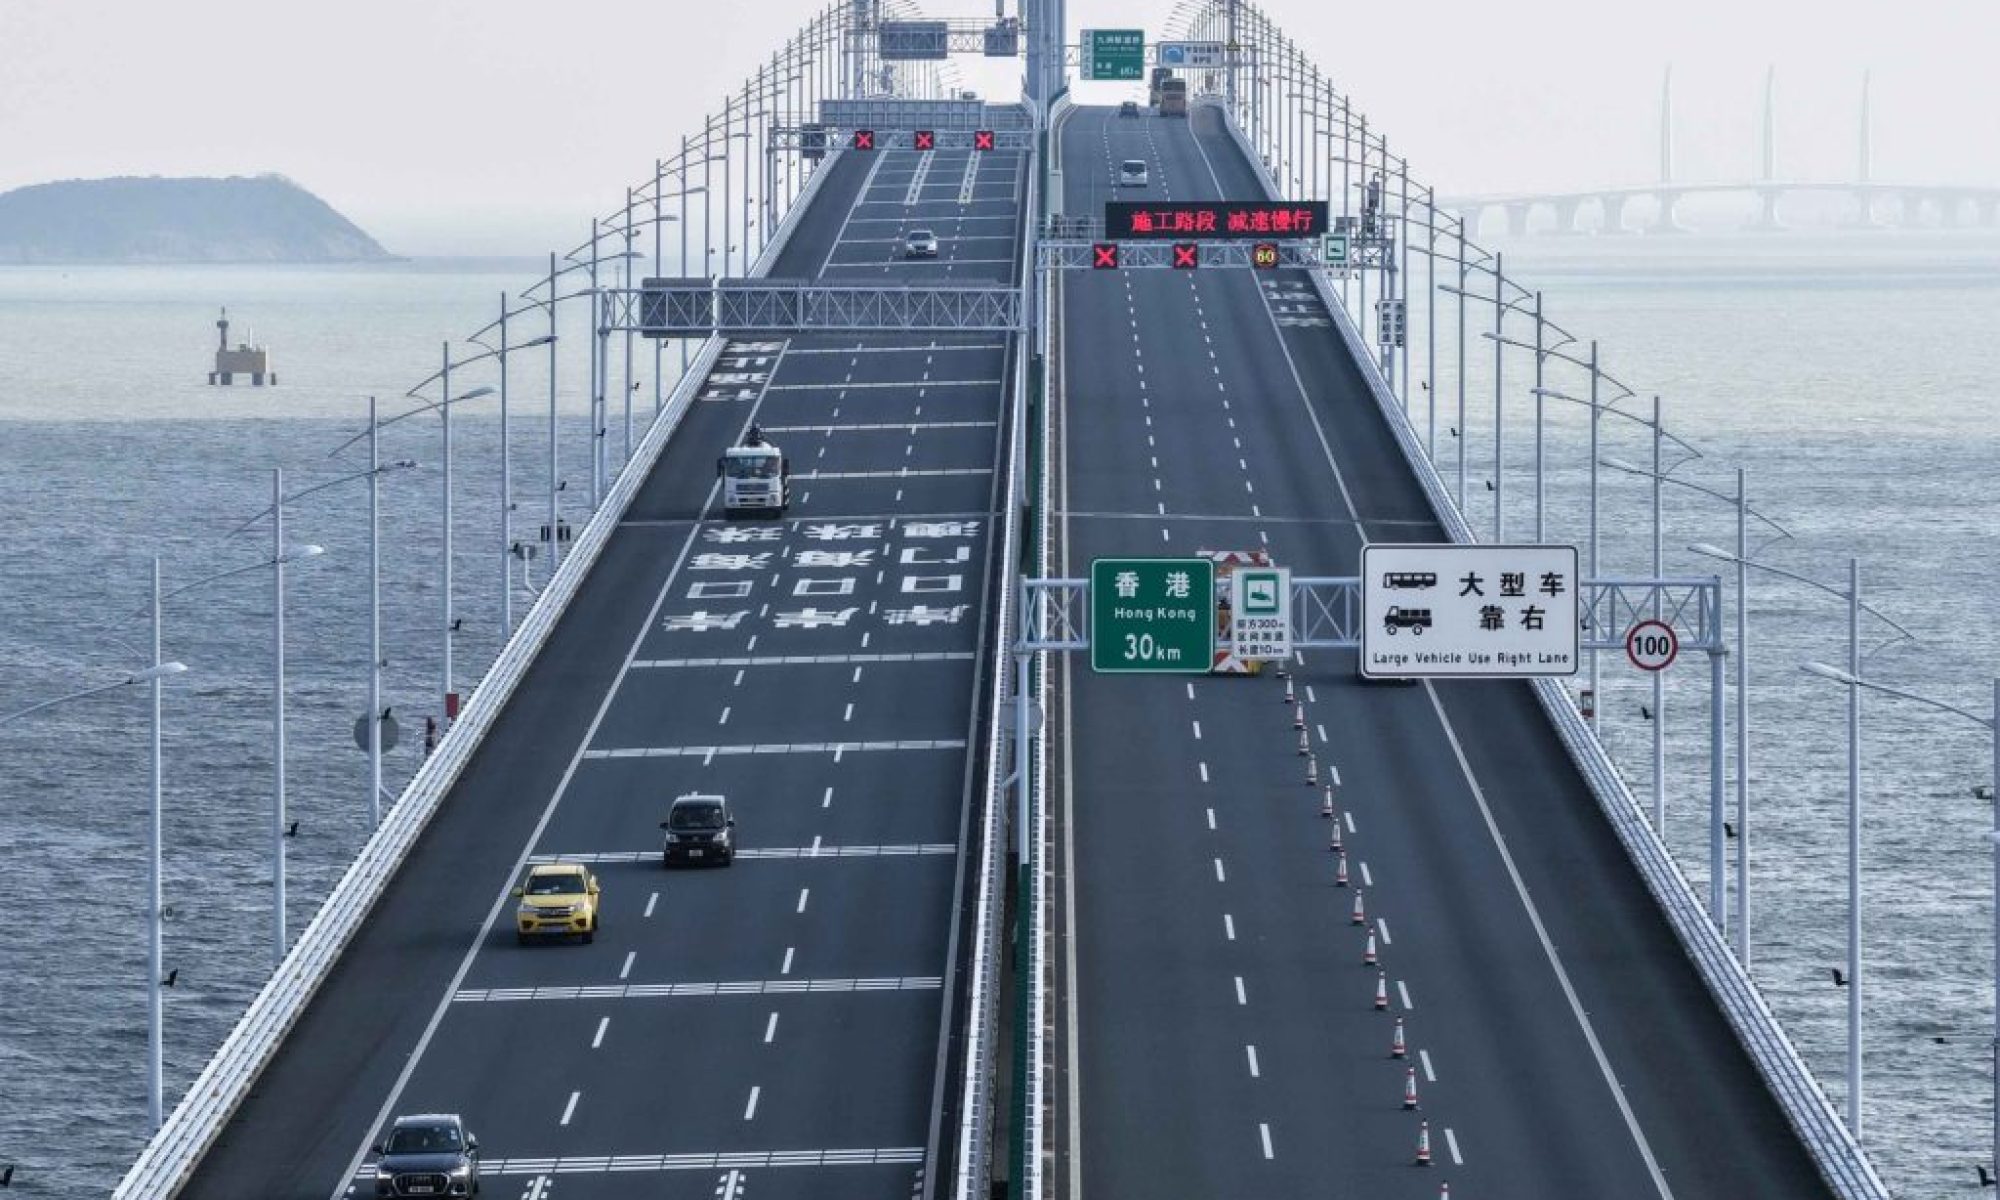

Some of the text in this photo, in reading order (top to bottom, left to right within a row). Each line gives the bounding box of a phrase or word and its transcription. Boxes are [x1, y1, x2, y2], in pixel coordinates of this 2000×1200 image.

[1131, 210, 1314, 232] 施工路段 减速慢行
[1256, 248, 1276, 264] 60
[1114, 571, 1191, 598] 香港
[1458, 570, 1566, 598] 大型车
[1114, 607, 1196, 622] Hong Kong
[1478, 604, 1546, 632] 靠右
[1633, 636, 1669, 656] 100
[1374, 652, 1569, 667] Large Vehicle Use Right Lane
